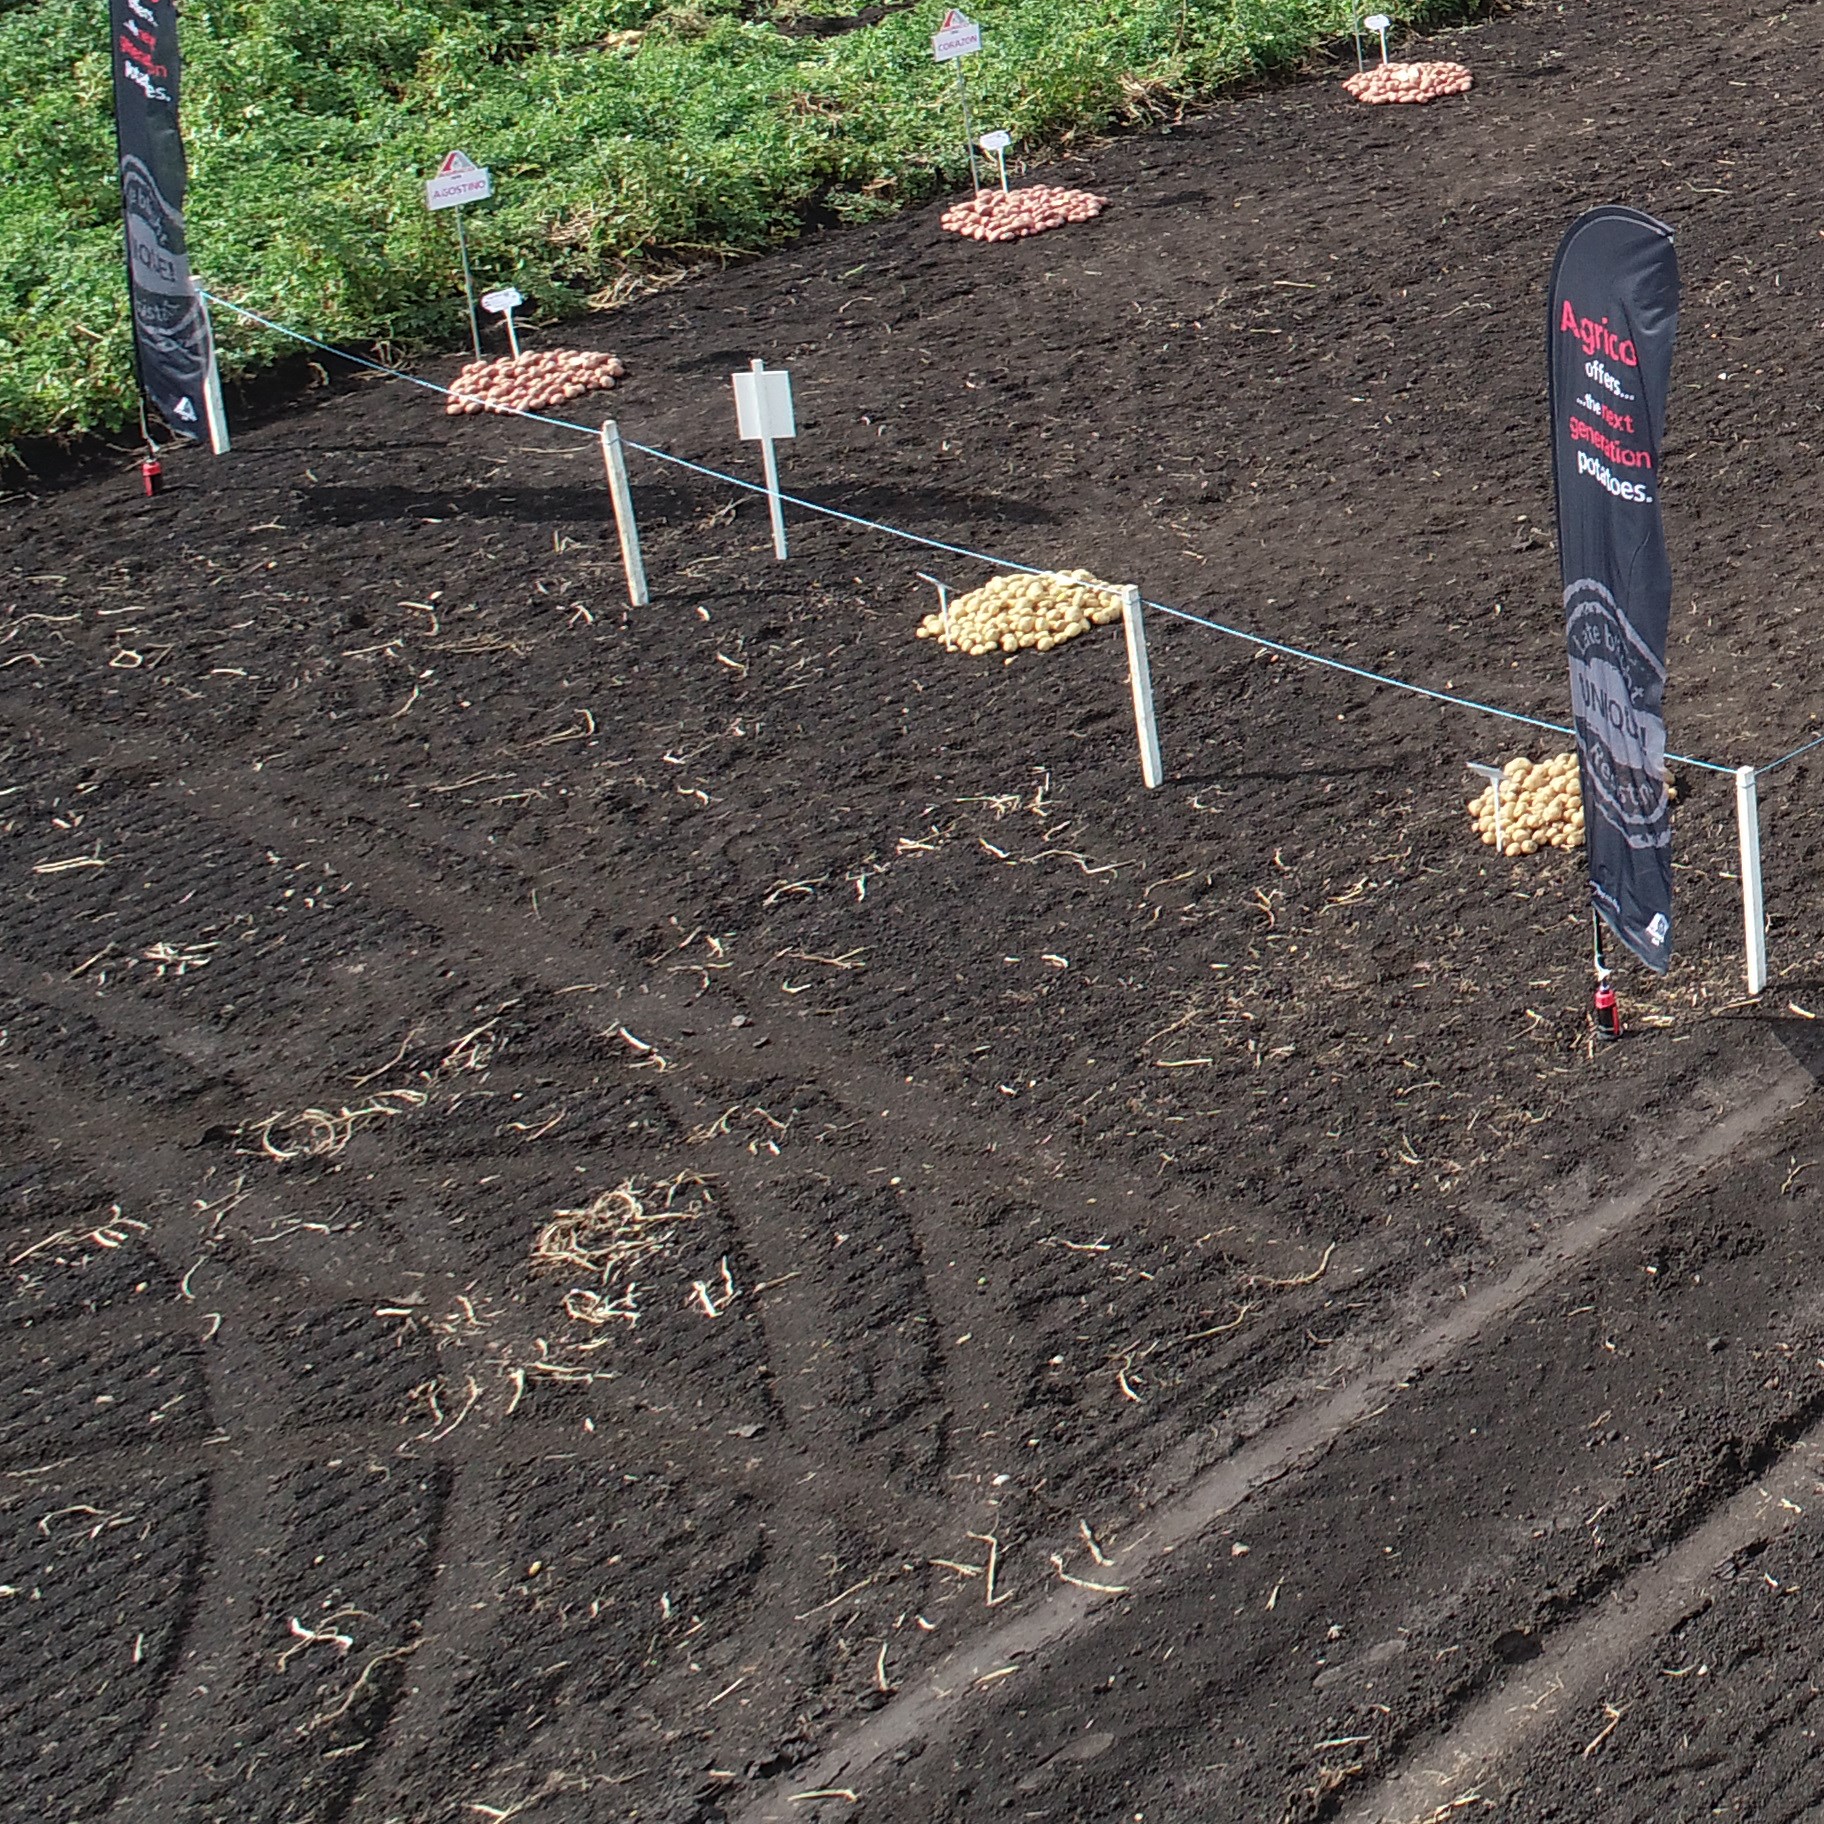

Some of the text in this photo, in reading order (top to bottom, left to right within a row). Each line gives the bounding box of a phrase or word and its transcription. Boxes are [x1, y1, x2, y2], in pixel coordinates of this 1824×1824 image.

[938, 34, 978, 52] CORAZON
[433, 179, 487, 199] AGOSTINO
[1560, 299, 1638, 367] Agrico
[1601, 403, 1635, 434] next
[1569, 415, 1652, 469] generation
[1577, 449, 1653, 504] potatoes.
